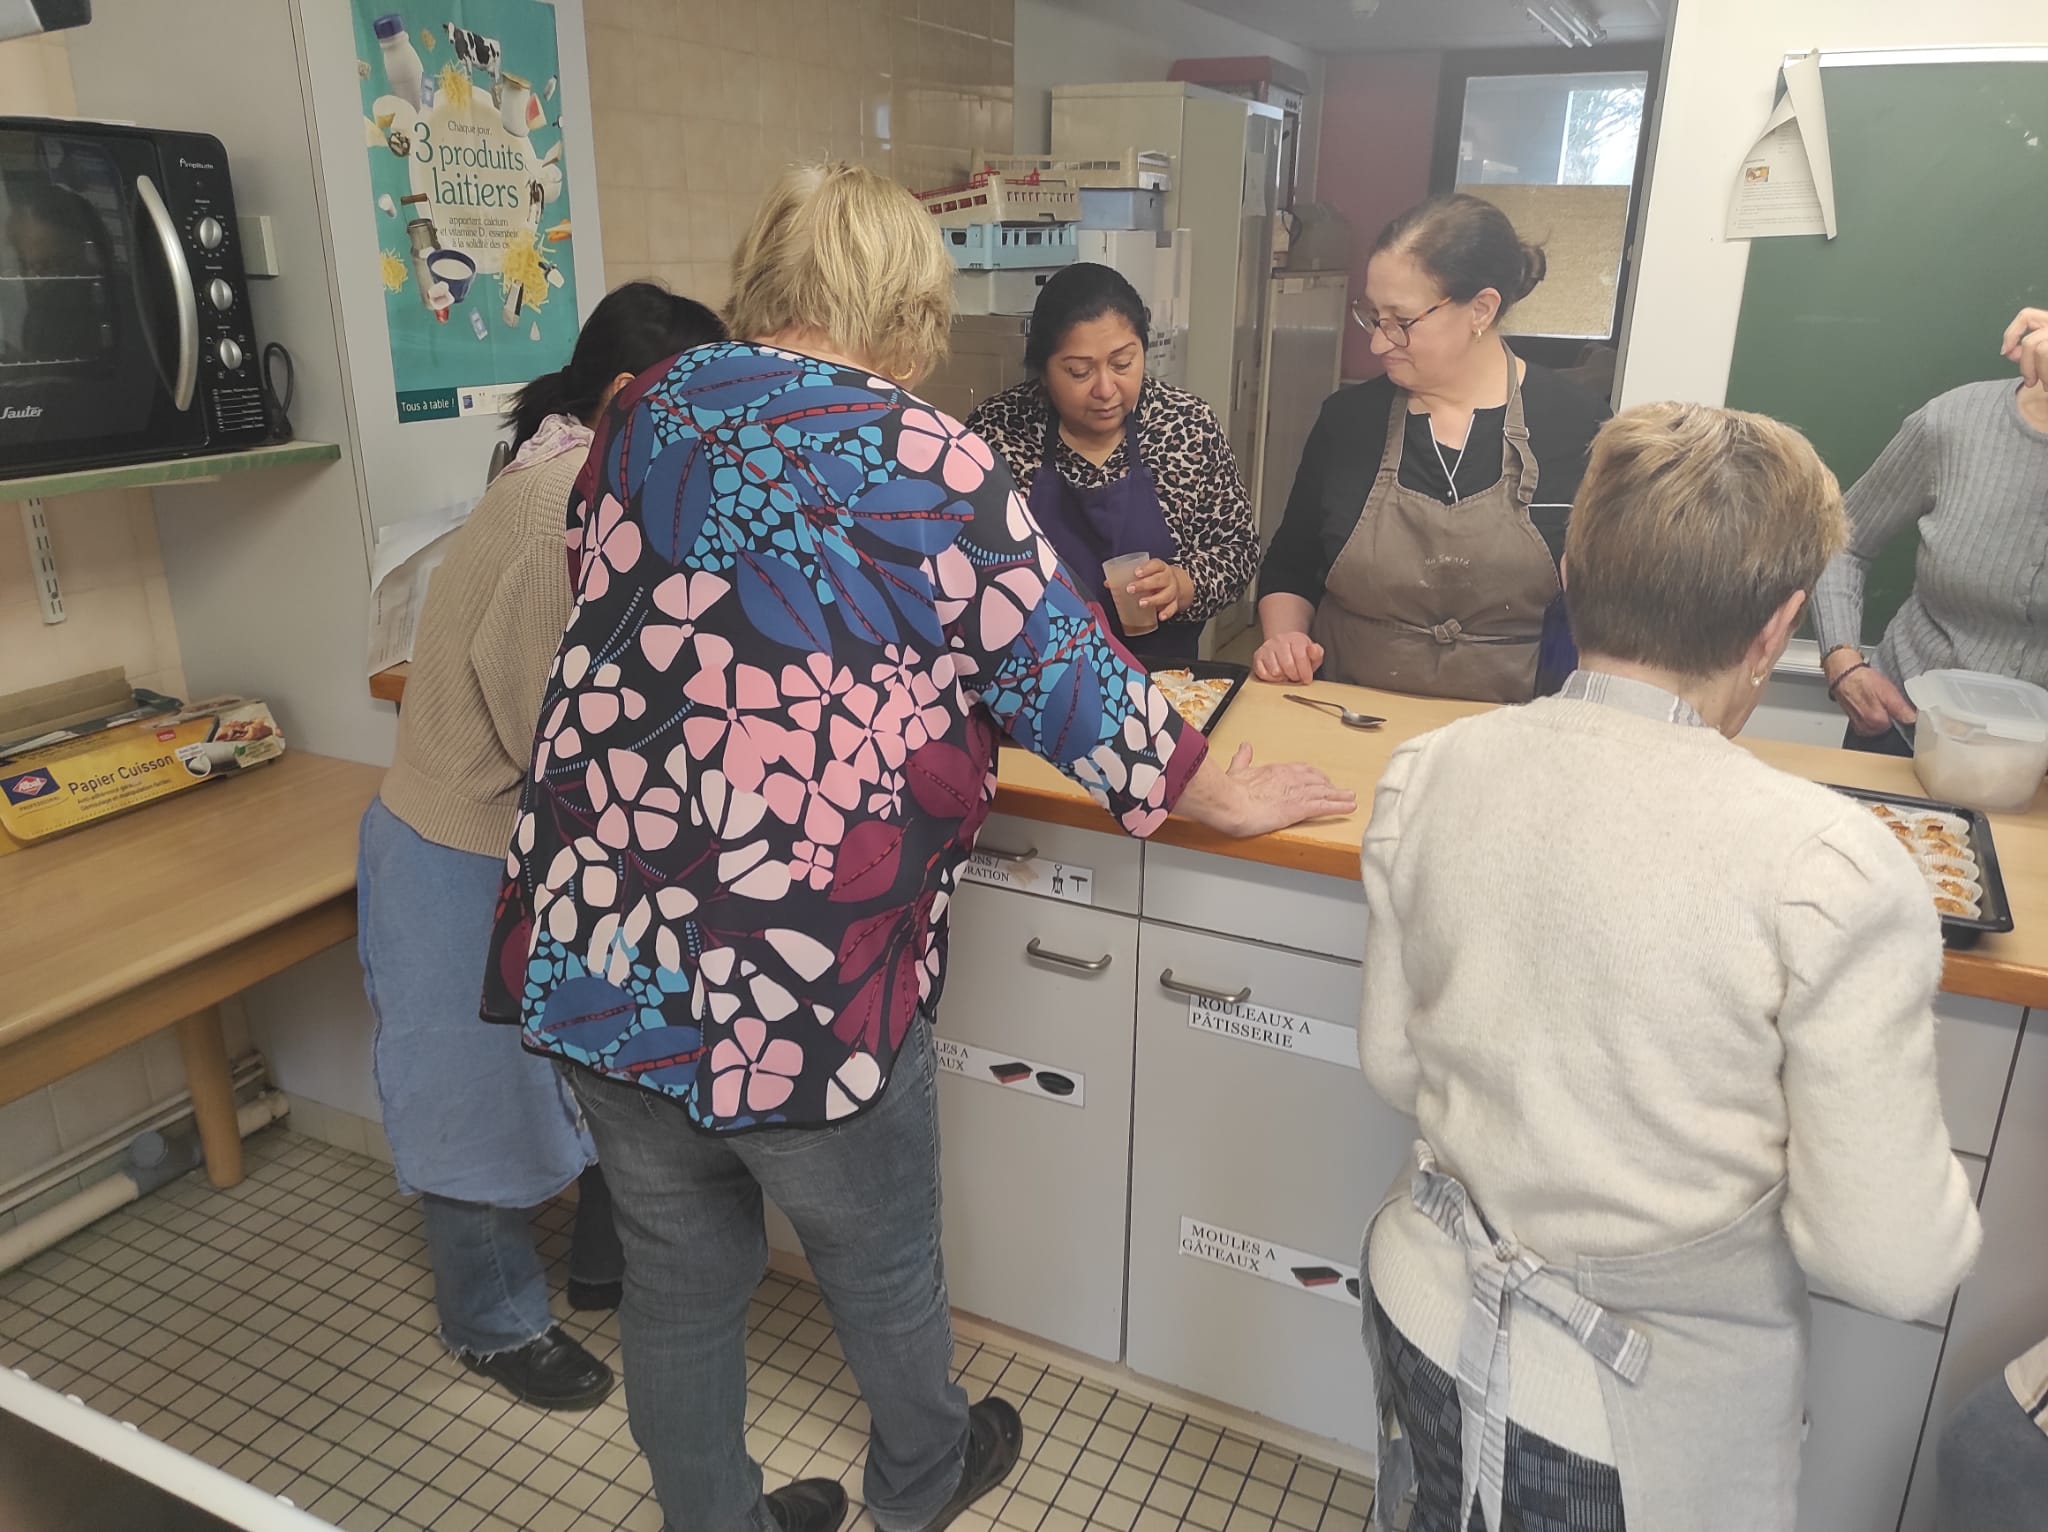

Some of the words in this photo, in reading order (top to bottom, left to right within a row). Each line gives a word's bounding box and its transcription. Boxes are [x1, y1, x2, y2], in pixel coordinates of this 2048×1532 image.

[414, 121, 433, 163] 3
[439, 138, 524, 171] produits
[448, 119, 475, 136] Chaque
[432, 166, 519, 209] laitiers
[0, 405, 44, 420] Sauter
[401, 401, 420, 413] Tous
[422, 400, 428, 411] à
[429, 399, 449, 410] table
[68, 773, 117, 796] Papier
[118, 754, 174, 780] Cuisson
[1191, 1010, 1294, 1049] PÂTISSERIE
[1198, 995, 1294, 1031] ROULEAUX
[1299, 1020, 1312, 1036] A
[960, 1047, 969, 1060] A
[1191, 1223, 1261, 1256] MOULES
[1265, 1247, 1276, 1262] A
